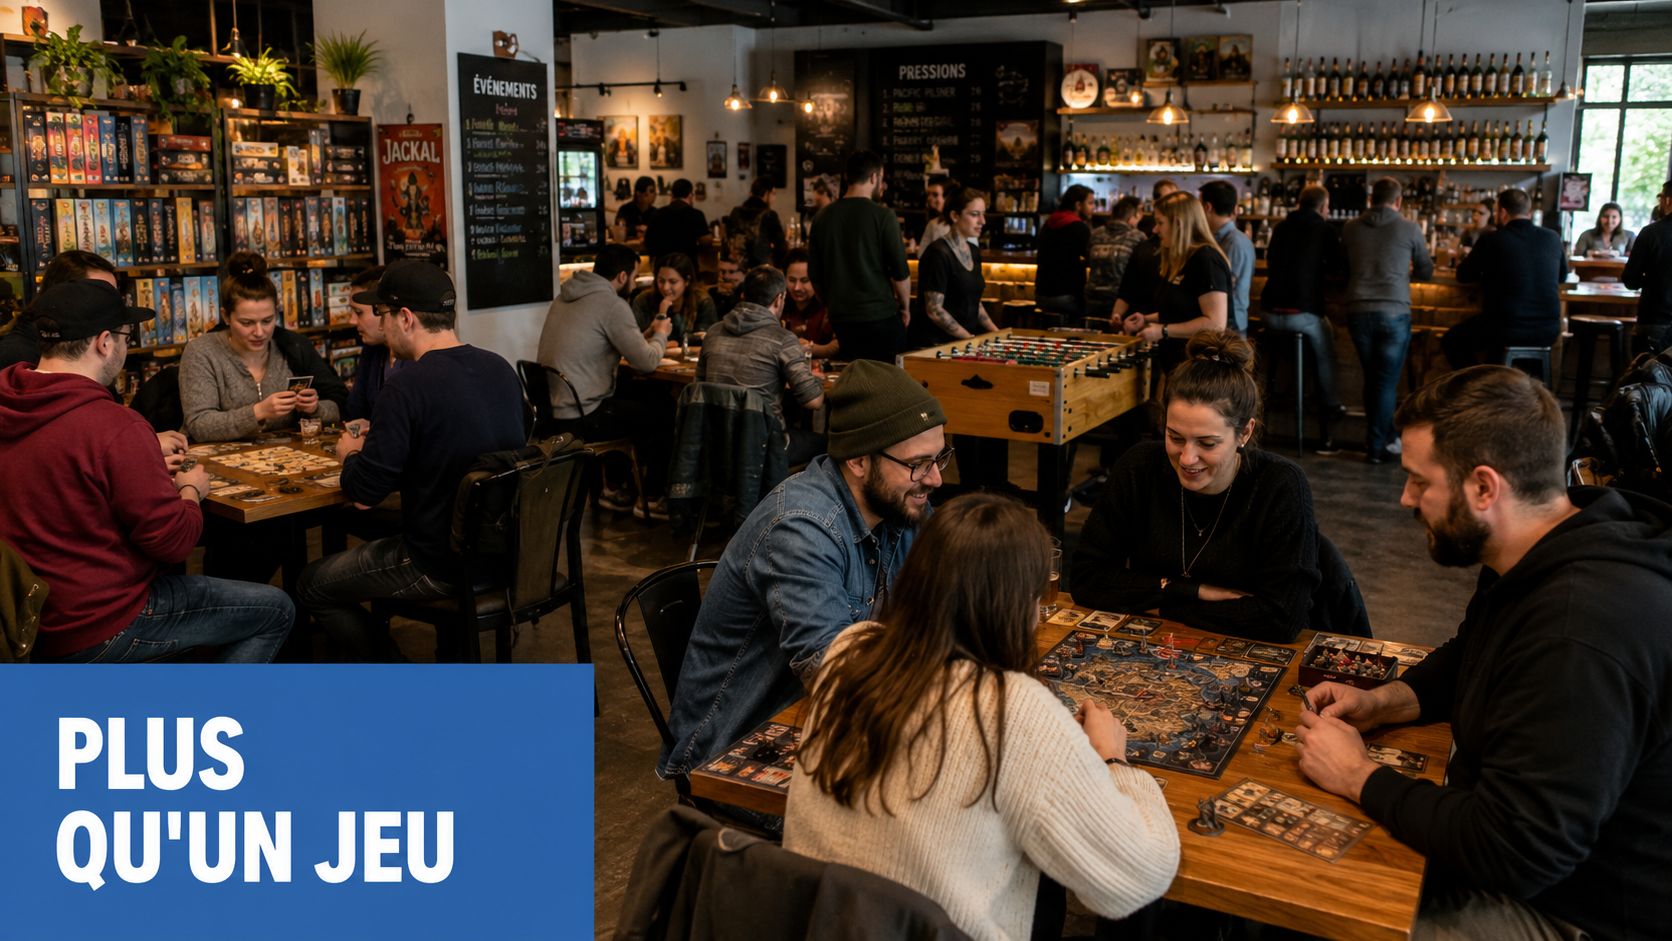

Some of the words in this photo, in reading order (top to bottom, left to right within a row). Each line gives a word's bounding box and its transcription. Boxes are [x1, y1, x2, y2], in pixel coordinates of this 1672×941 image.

[899, 63, 966, 80] PRESSIONS
[473, 74, 537, 100] ÉVÉNEMENTS
[383, 139, 440, 164] JACKAL
